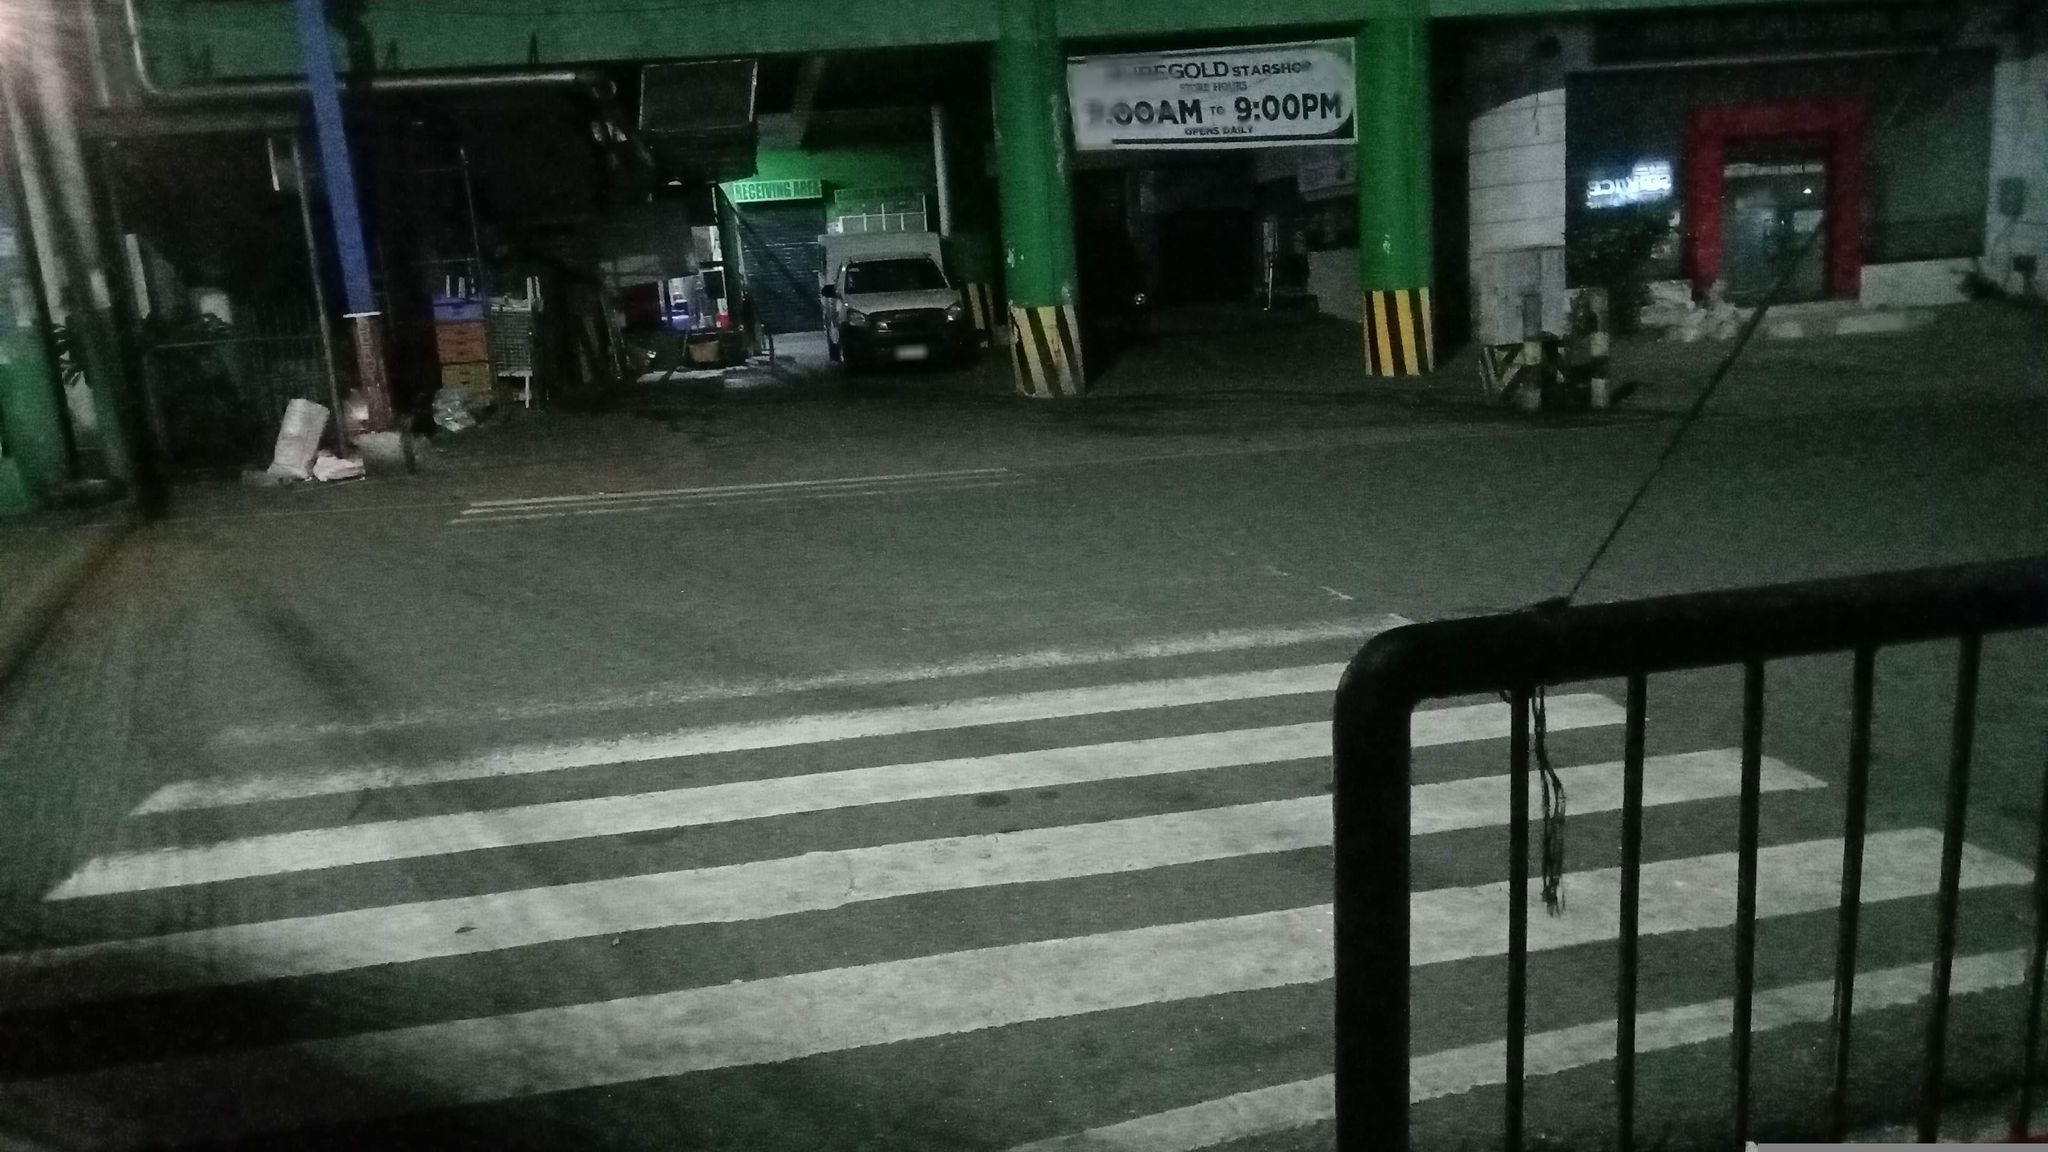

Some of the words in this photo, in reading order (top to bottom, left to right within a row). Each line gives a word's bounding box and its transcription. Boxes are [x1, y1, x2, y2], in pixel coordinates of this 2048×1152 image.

[1103, 61, 1229, 82] REGOLD
[1088, 99, 1203, 125] :00AM
[1234, 93, 1342, 122] 9:00PM
[734, 182, 792, 200] RECEIVING
